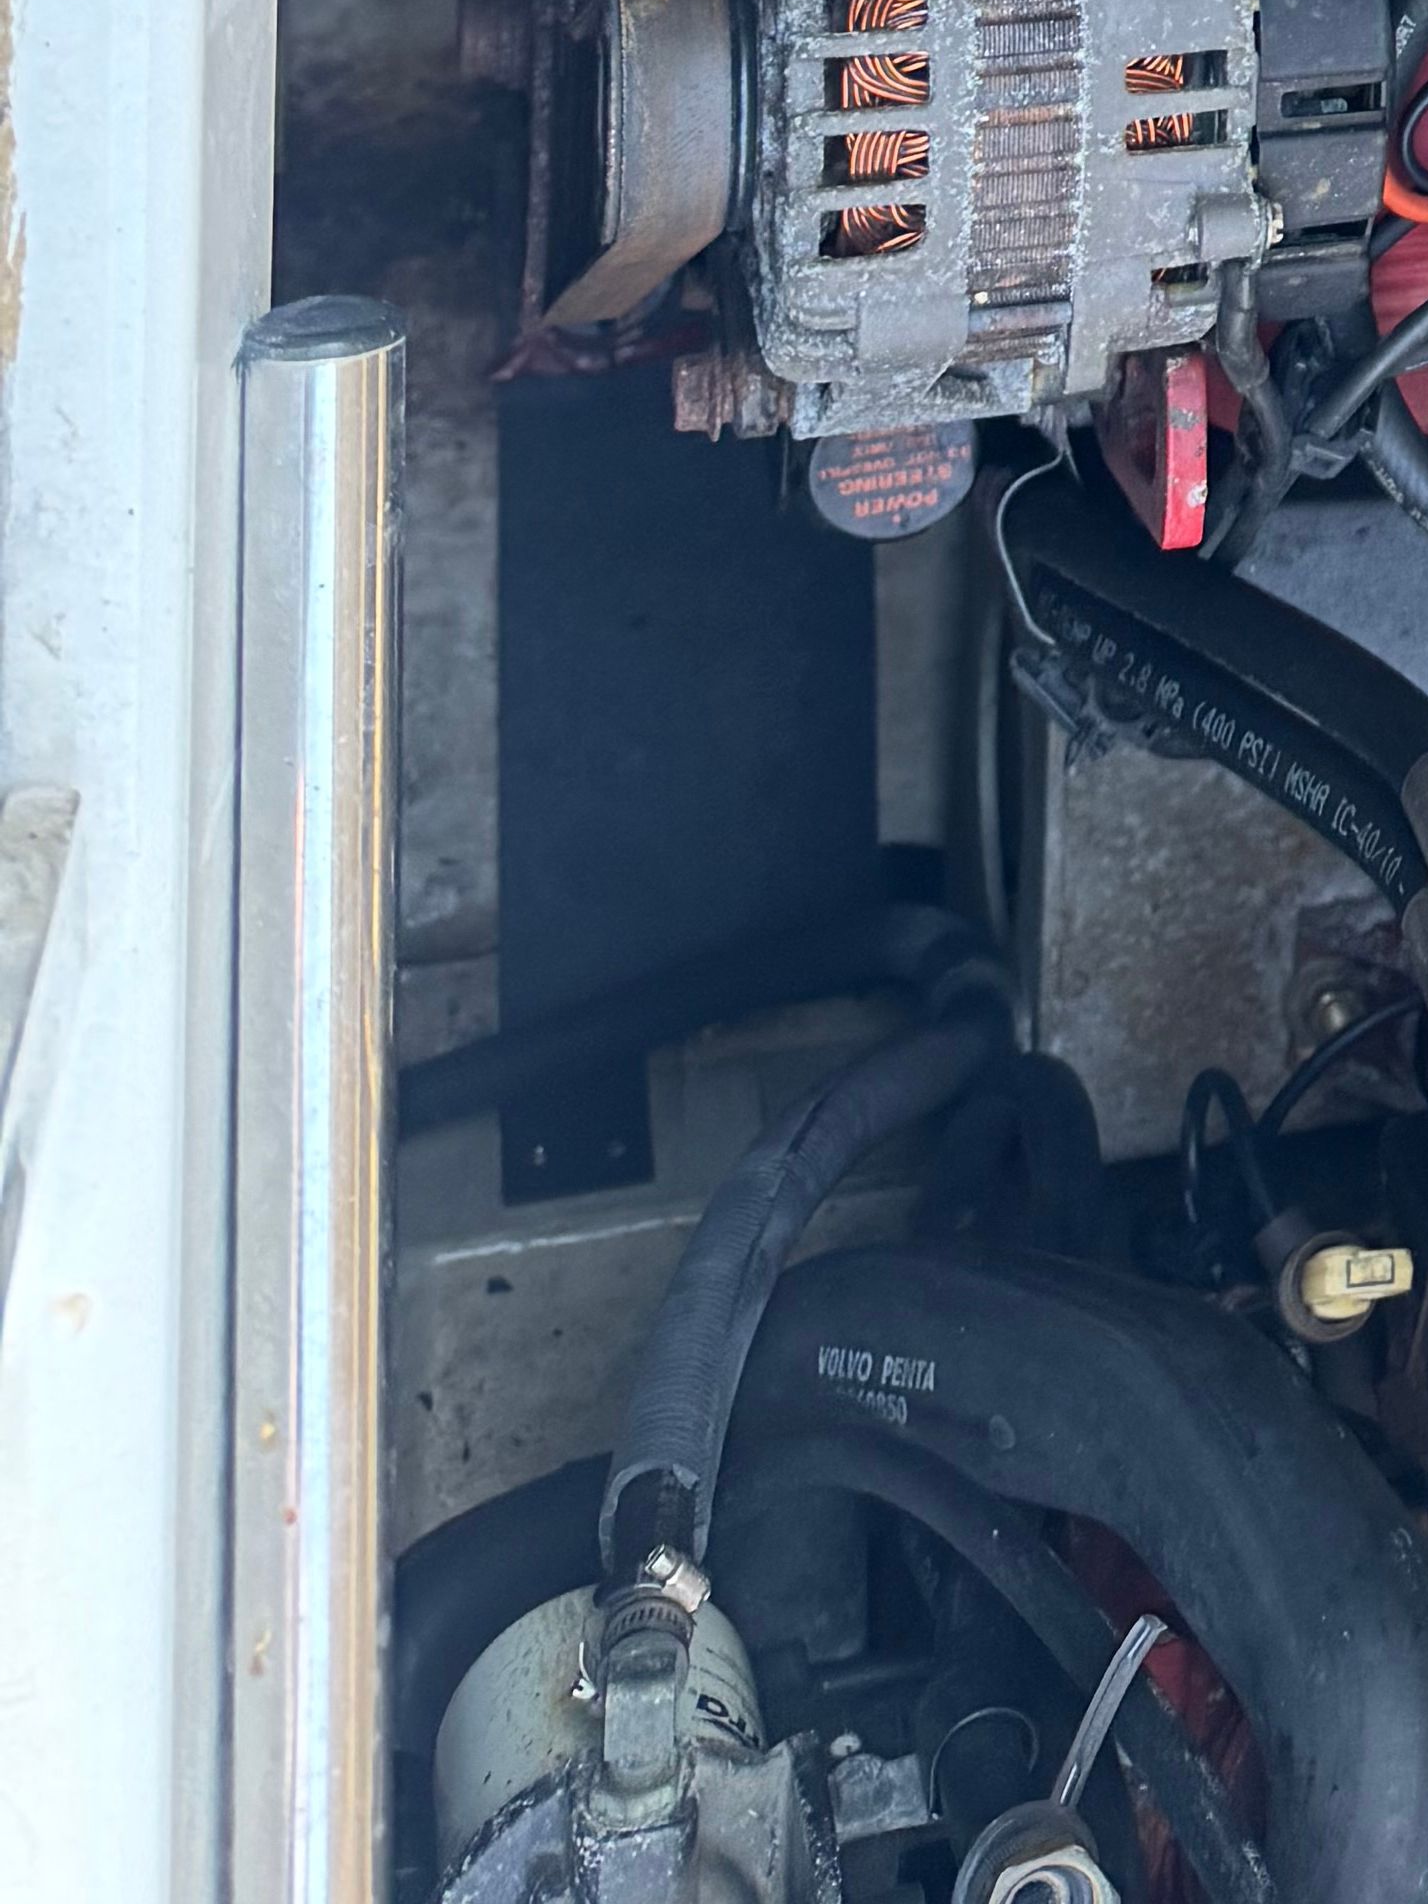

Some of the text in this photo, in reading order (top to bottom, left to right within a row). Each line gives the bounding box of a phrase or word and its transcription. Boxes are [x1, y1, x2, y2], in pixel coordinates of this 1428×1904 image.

[838, 464, 952, 495] STEERING
[855, 489, 938, 517] POWER
[818, 1346, 936, 1391] VOLVO PENTA
